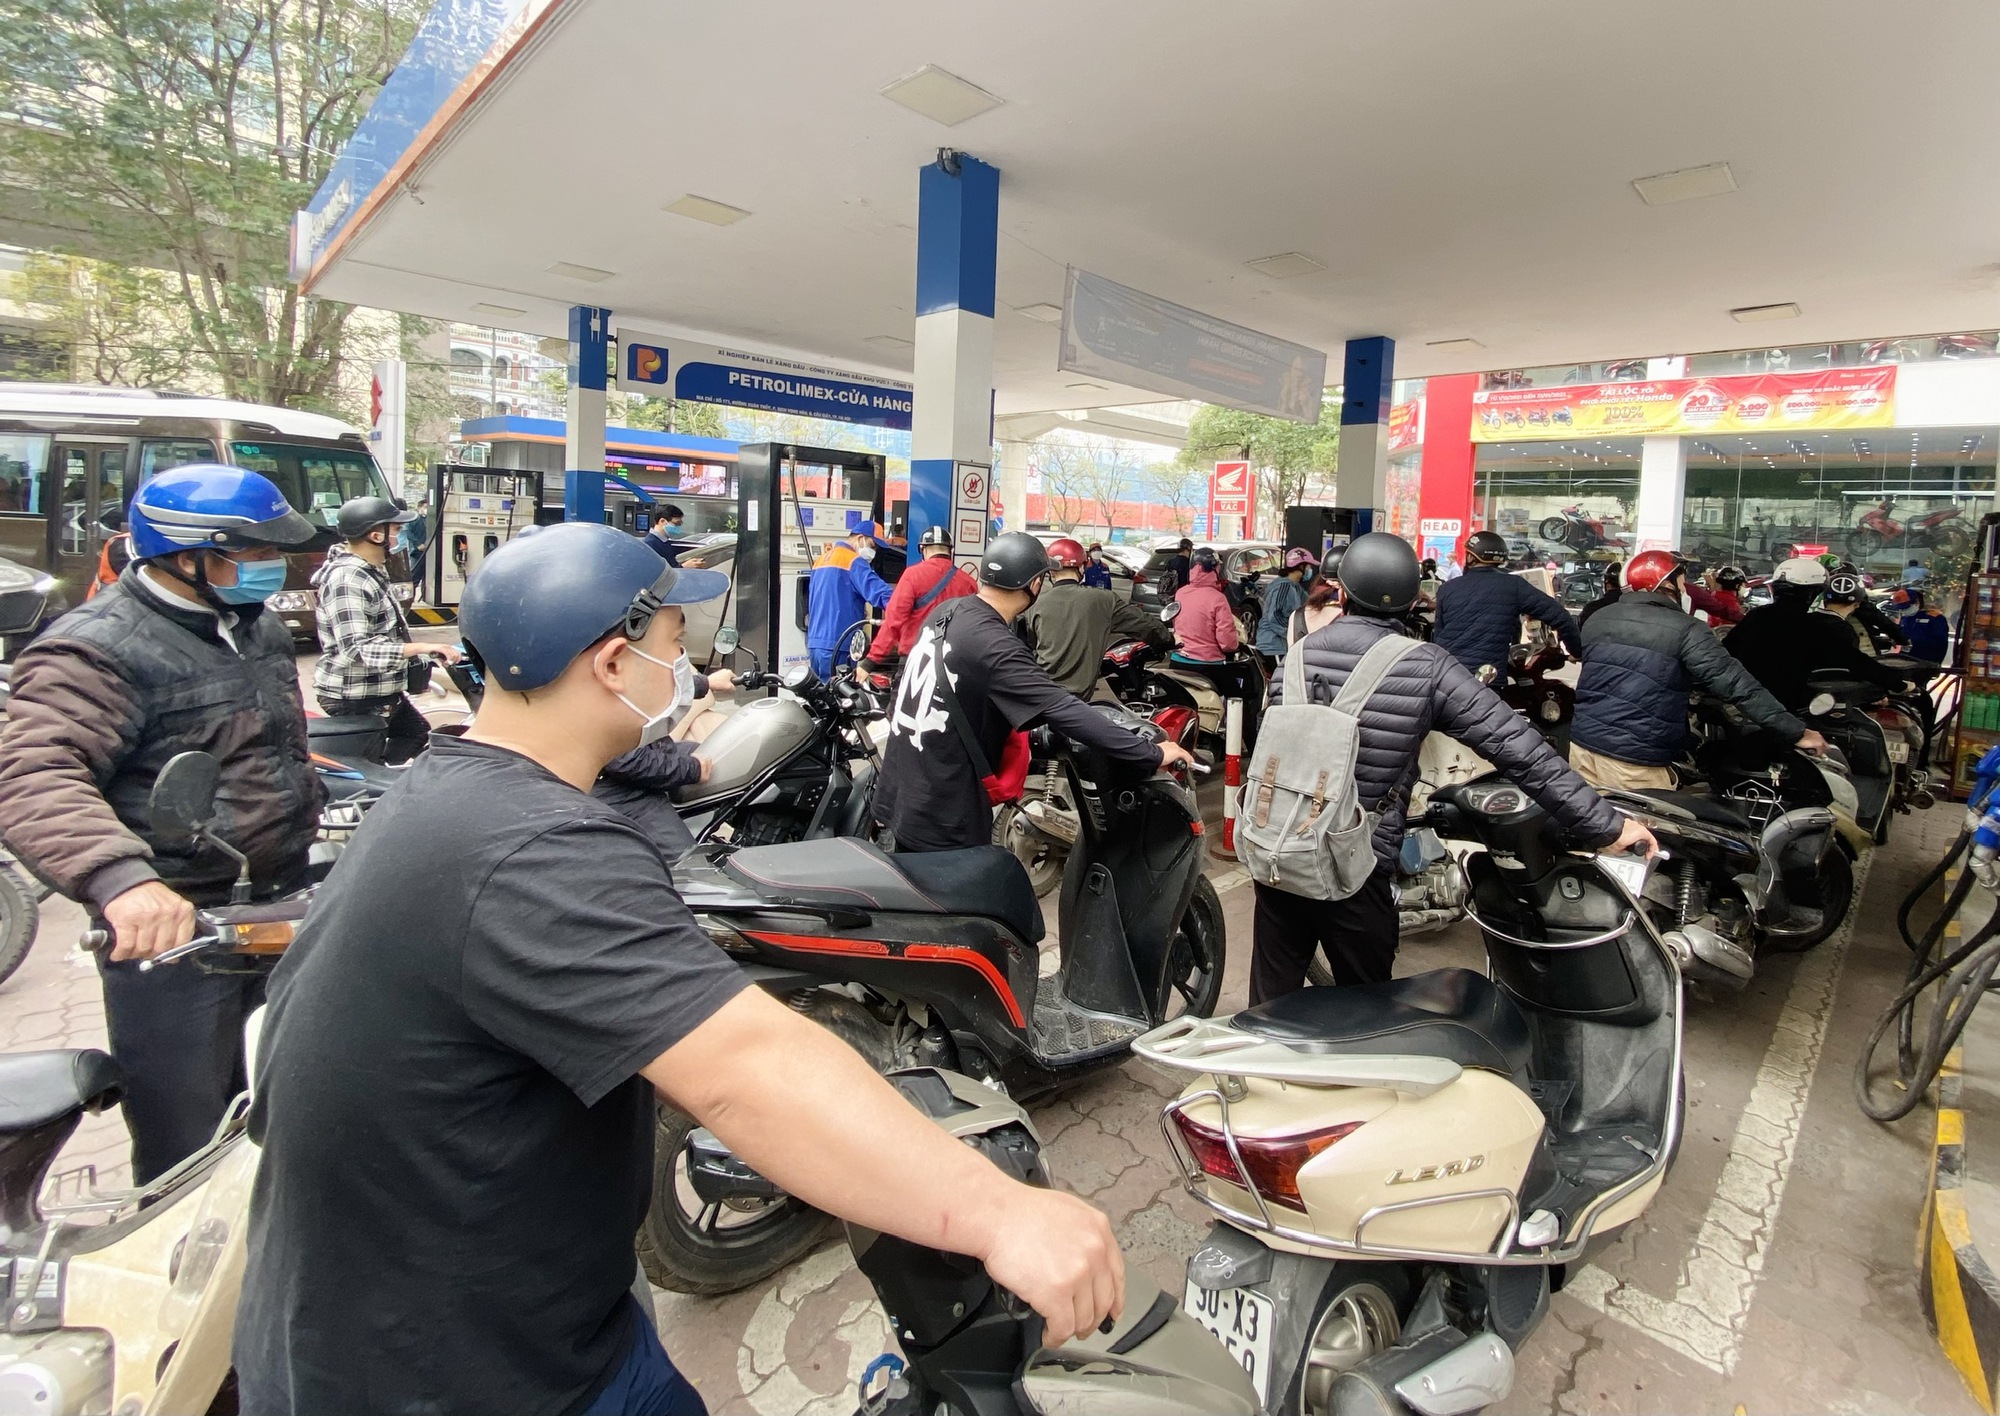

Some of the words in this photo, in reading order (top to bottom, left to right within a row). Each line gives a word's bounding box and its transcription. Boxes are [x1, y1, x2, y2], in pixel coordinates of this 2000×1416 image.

[728, 371, 869, 407] PETROLIMEX-CỬA
[873, 393, 912, 413] HÀNG
[1618, 385, 1639, 397] LỘC
[1635, 392, 1674, 404] Honda
[1686, 395, 1710, 407] 20
[1604, 405, 1645, 419] 100%
[1738, 403, 1769, 411] 2.000
[1423, 521, 1459, 532] HEAD
[1385, 1154, 1486, 1186] LEAD
